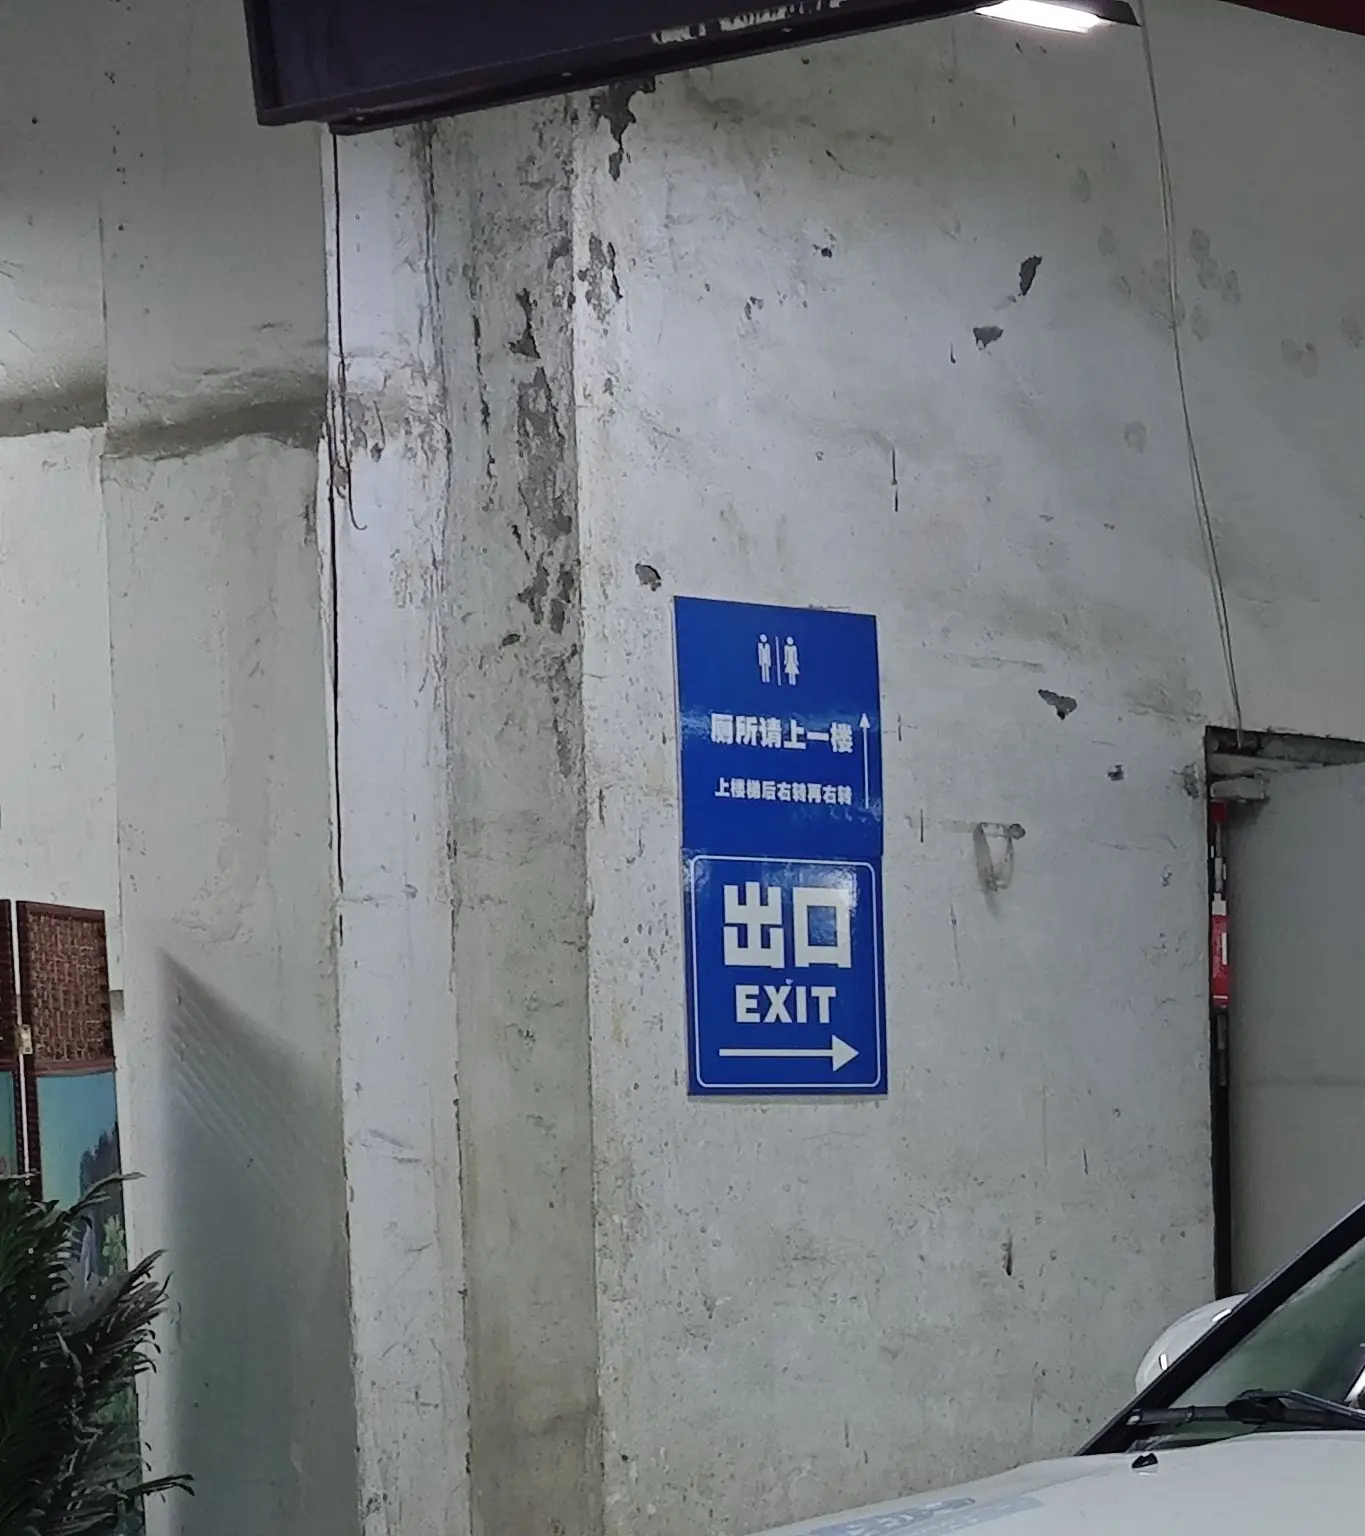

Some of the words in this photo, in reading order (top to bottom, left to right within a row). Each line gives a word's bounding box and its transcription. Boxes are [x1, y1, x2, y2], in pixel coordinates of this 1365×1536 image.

[710, 712, 854, 753] 厕所请上一楼
[714, 776, 852, 805] 上楼梯后右转再右转
[723, 881, 852, 969] 出口
[736, 984, 837, 1024] EXIT
